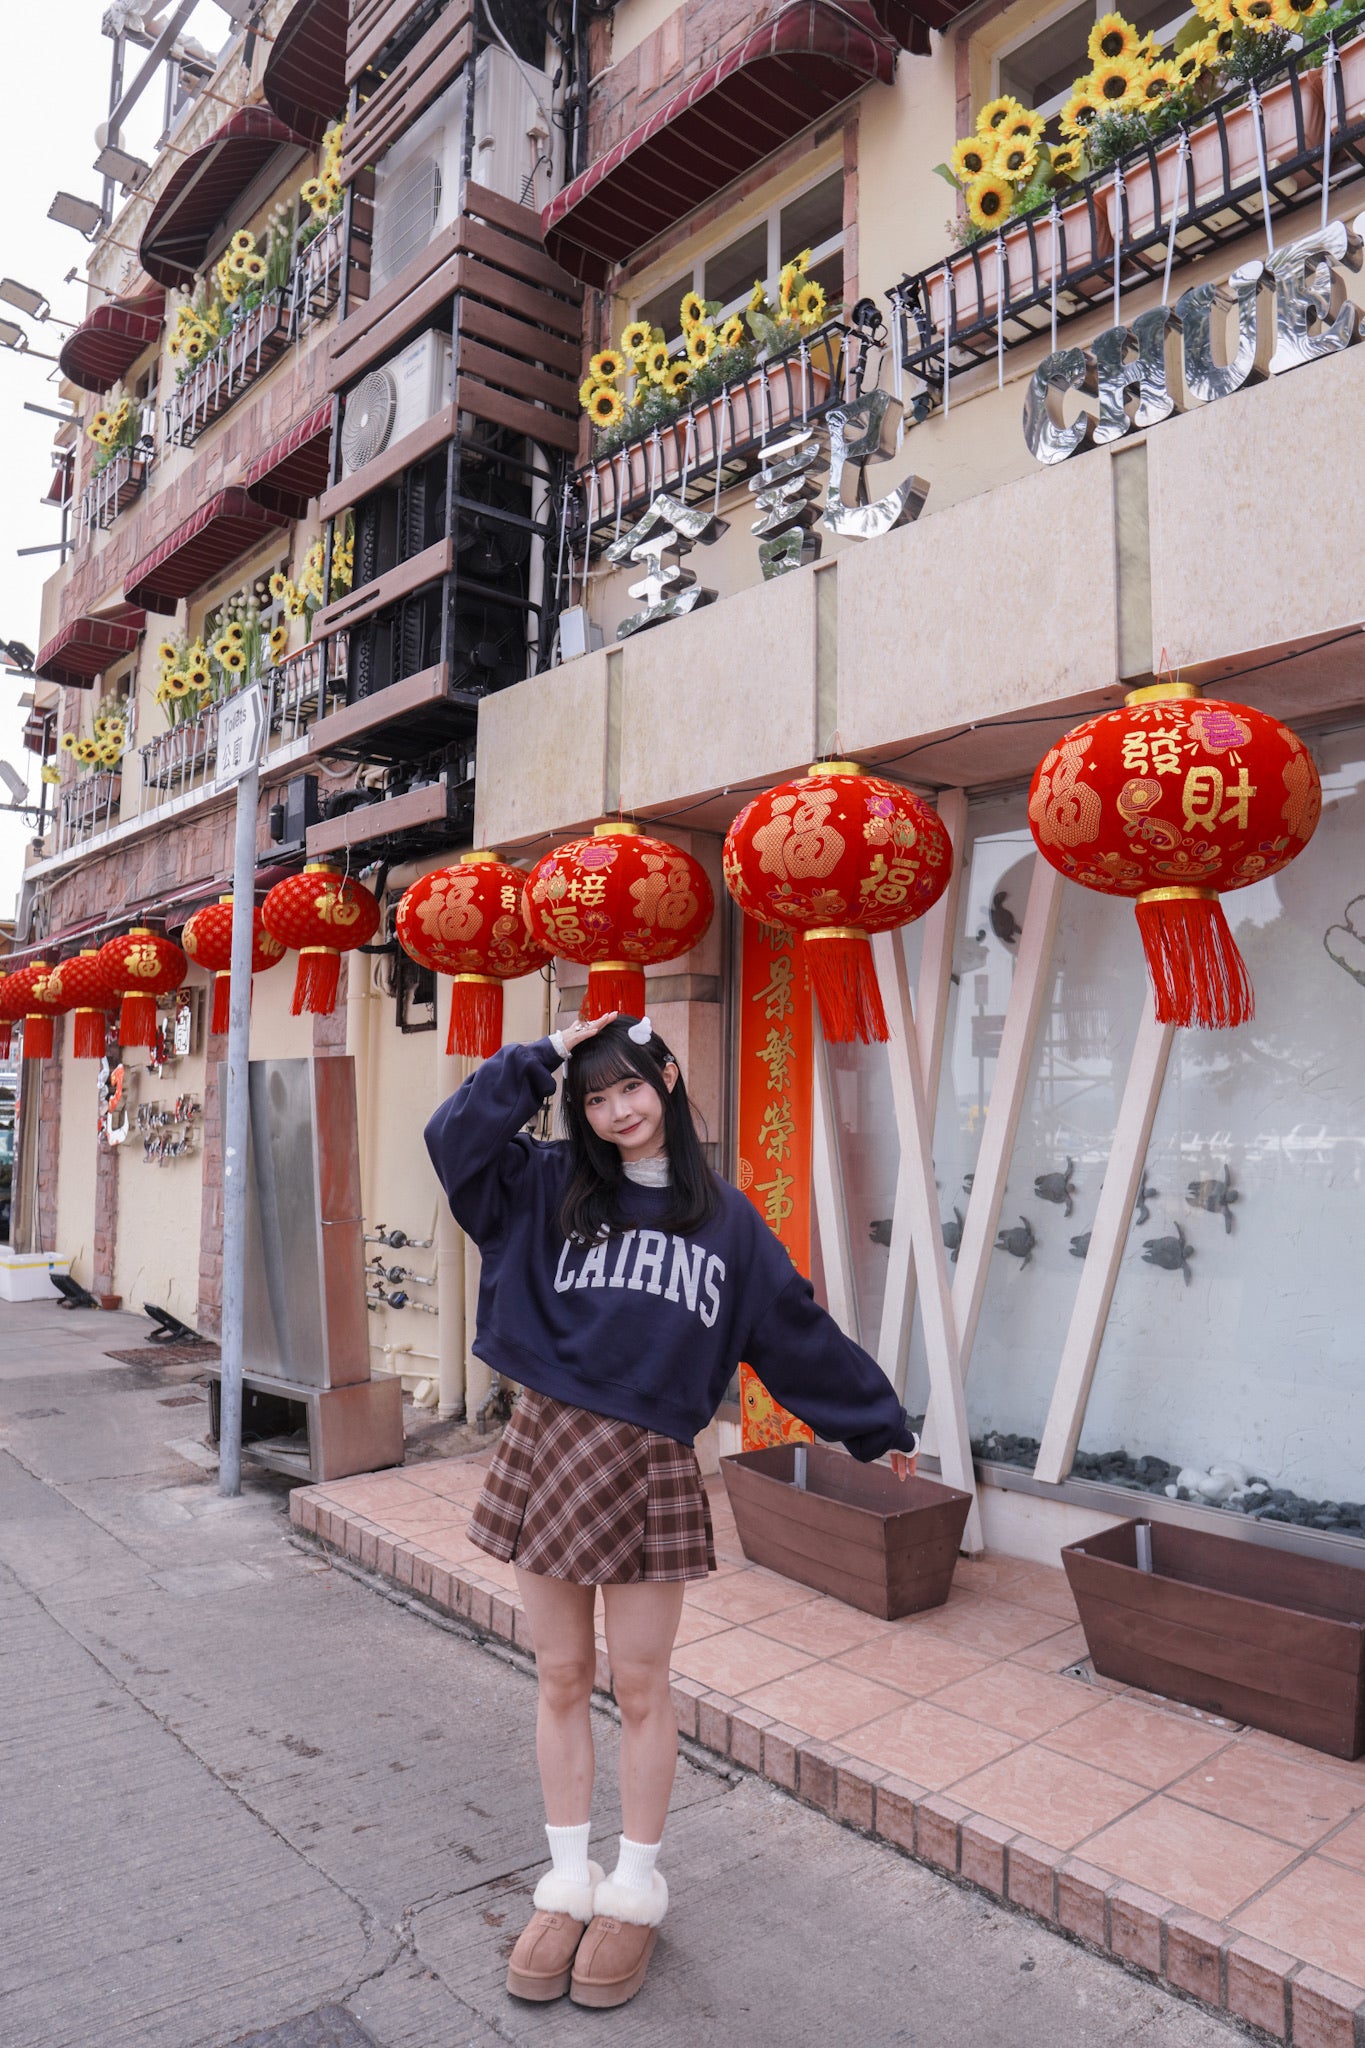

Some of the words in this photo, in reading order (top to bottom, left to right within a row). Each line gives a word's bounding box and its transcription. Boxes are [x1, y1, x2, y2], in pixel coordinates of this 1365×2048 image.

[1022, 213, 1365, 466] CHUE
[224, 708, 247, 735] Toilets
[752, 788, 845, 880] 福
[416, 875, 484, 941] 福
[124, 944, 162, 977] 福
[752, 922, 798, 1267] 景繁榮事
[554, 1222, 726, 1328] CAIRNS
